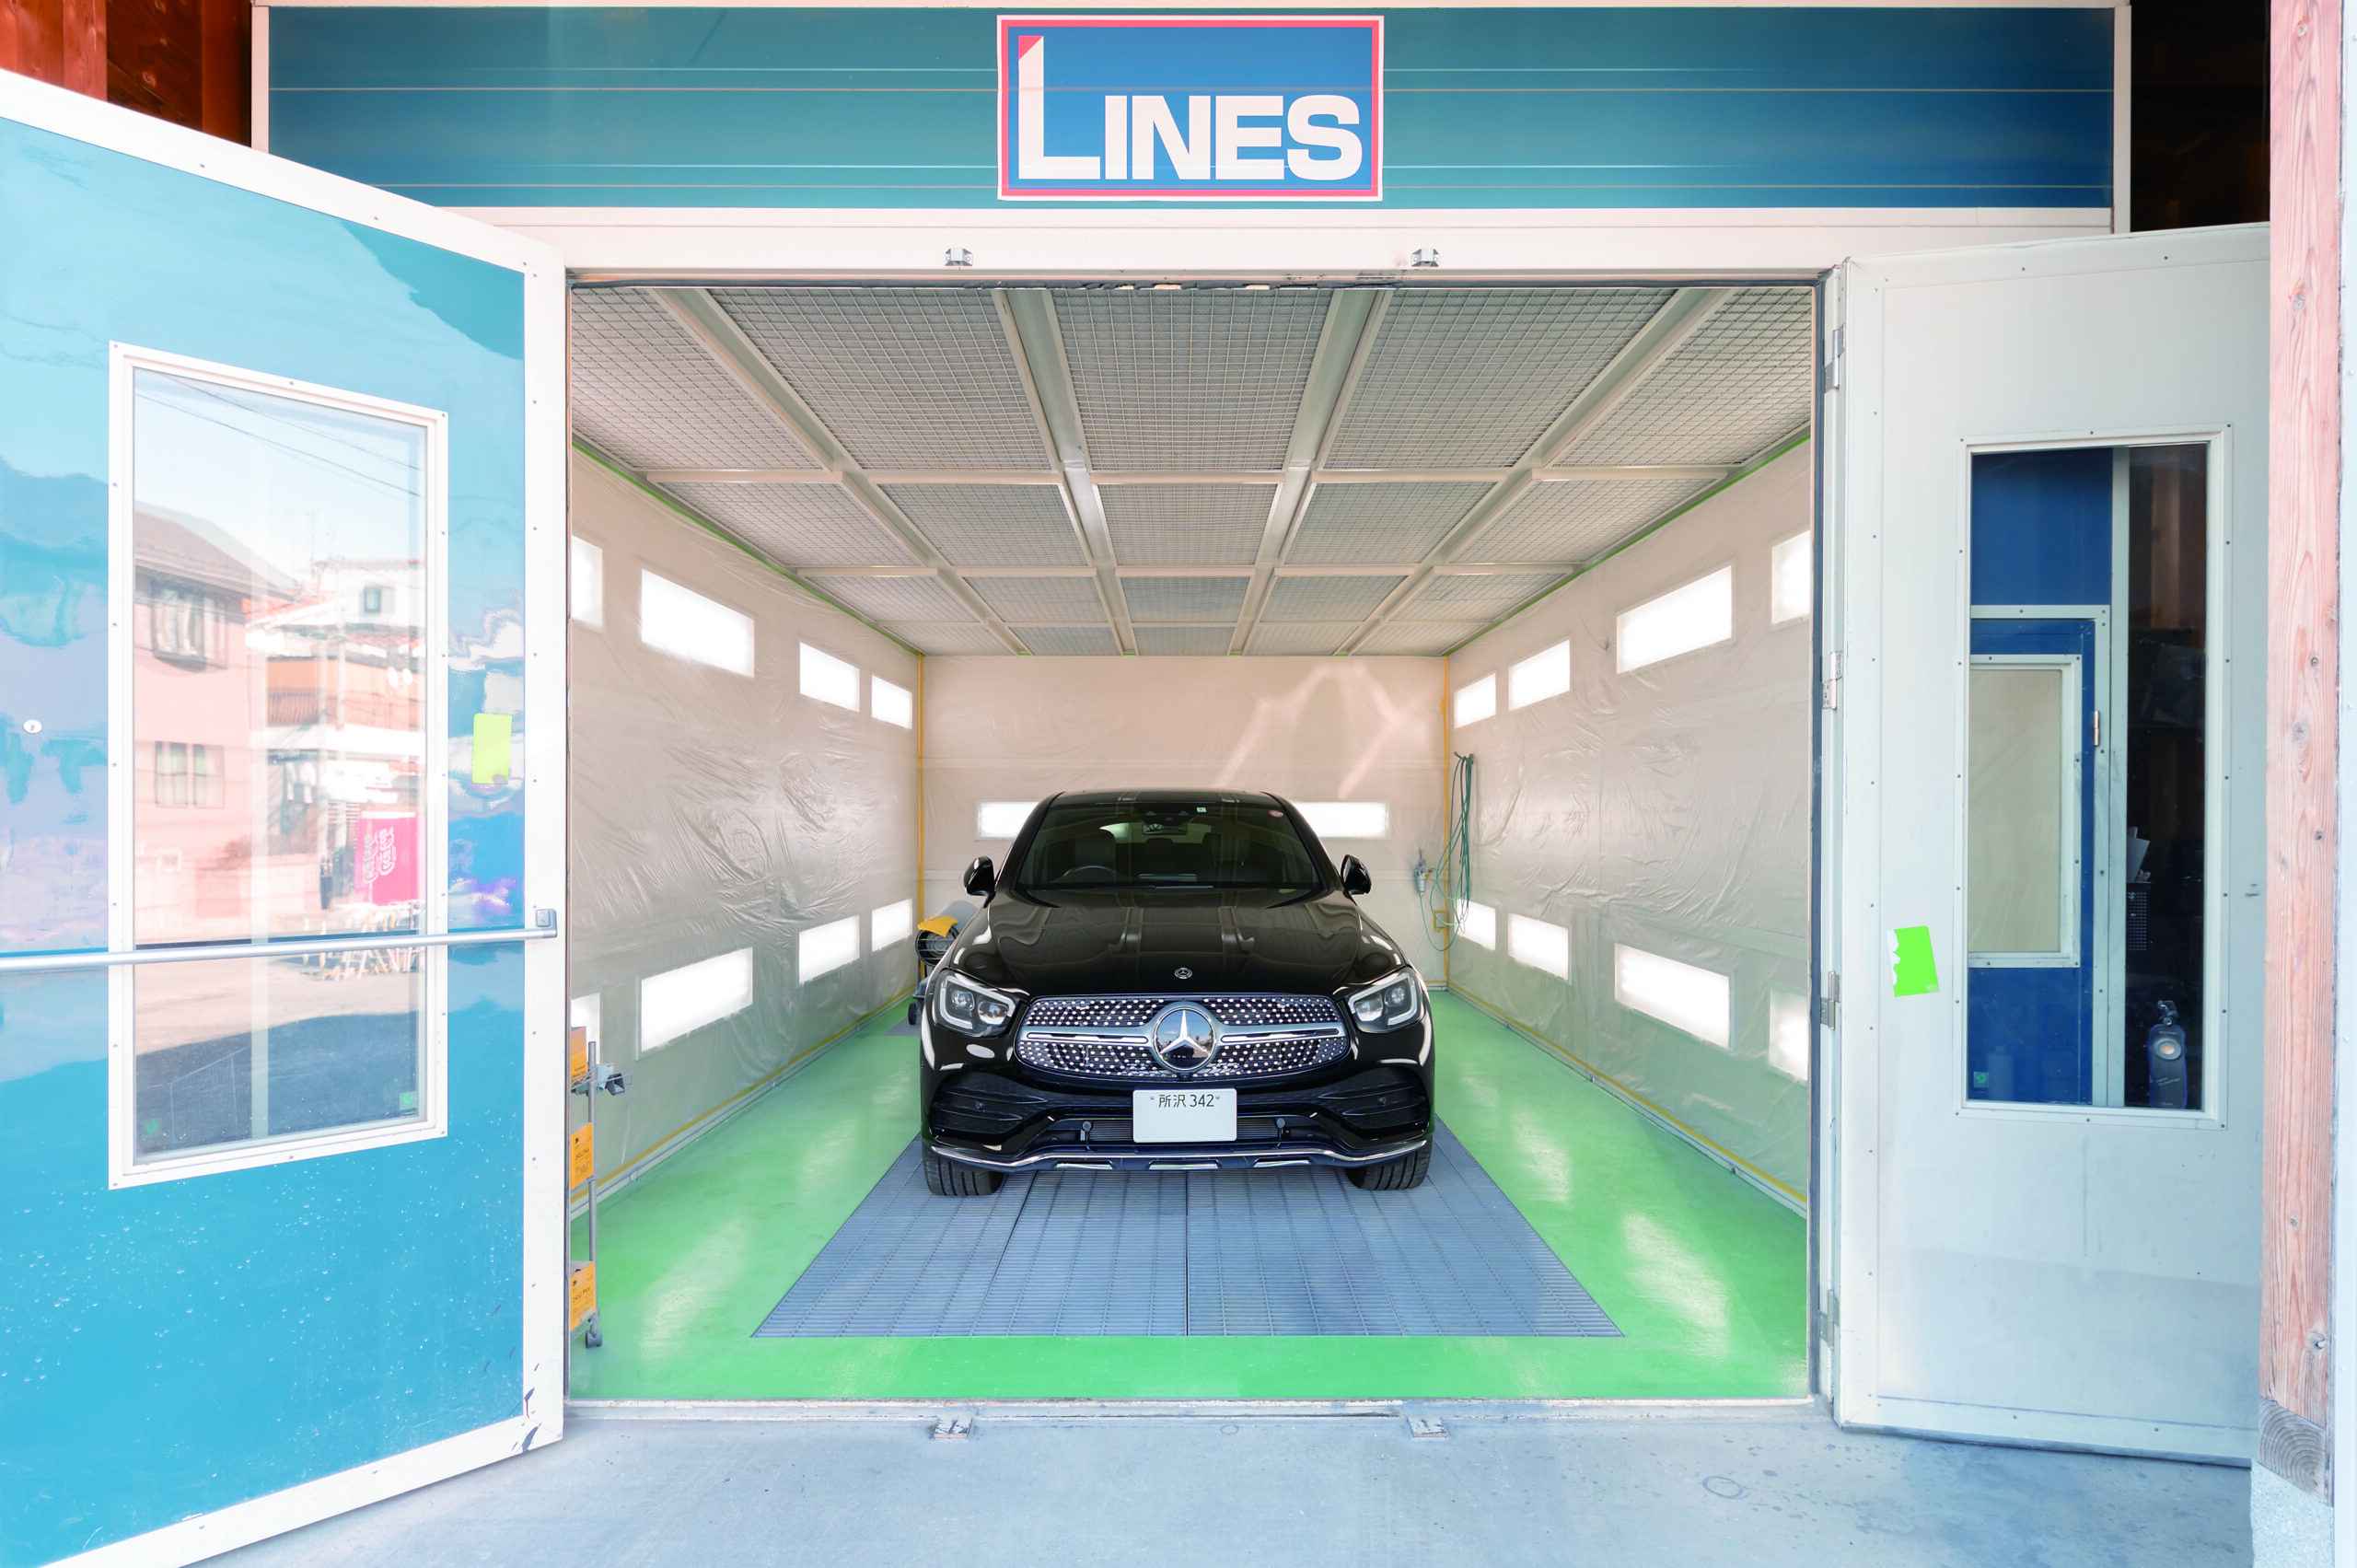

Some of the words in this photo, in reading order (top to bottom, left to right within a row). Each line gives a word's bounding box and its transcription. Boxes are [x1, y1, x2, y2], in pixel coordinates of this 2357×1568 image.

[1018, 35, 1363, 180] LINES
[1158, 1094, 1186, 1108] 所沢
[1190, 1094, 1214, 1108] 342
